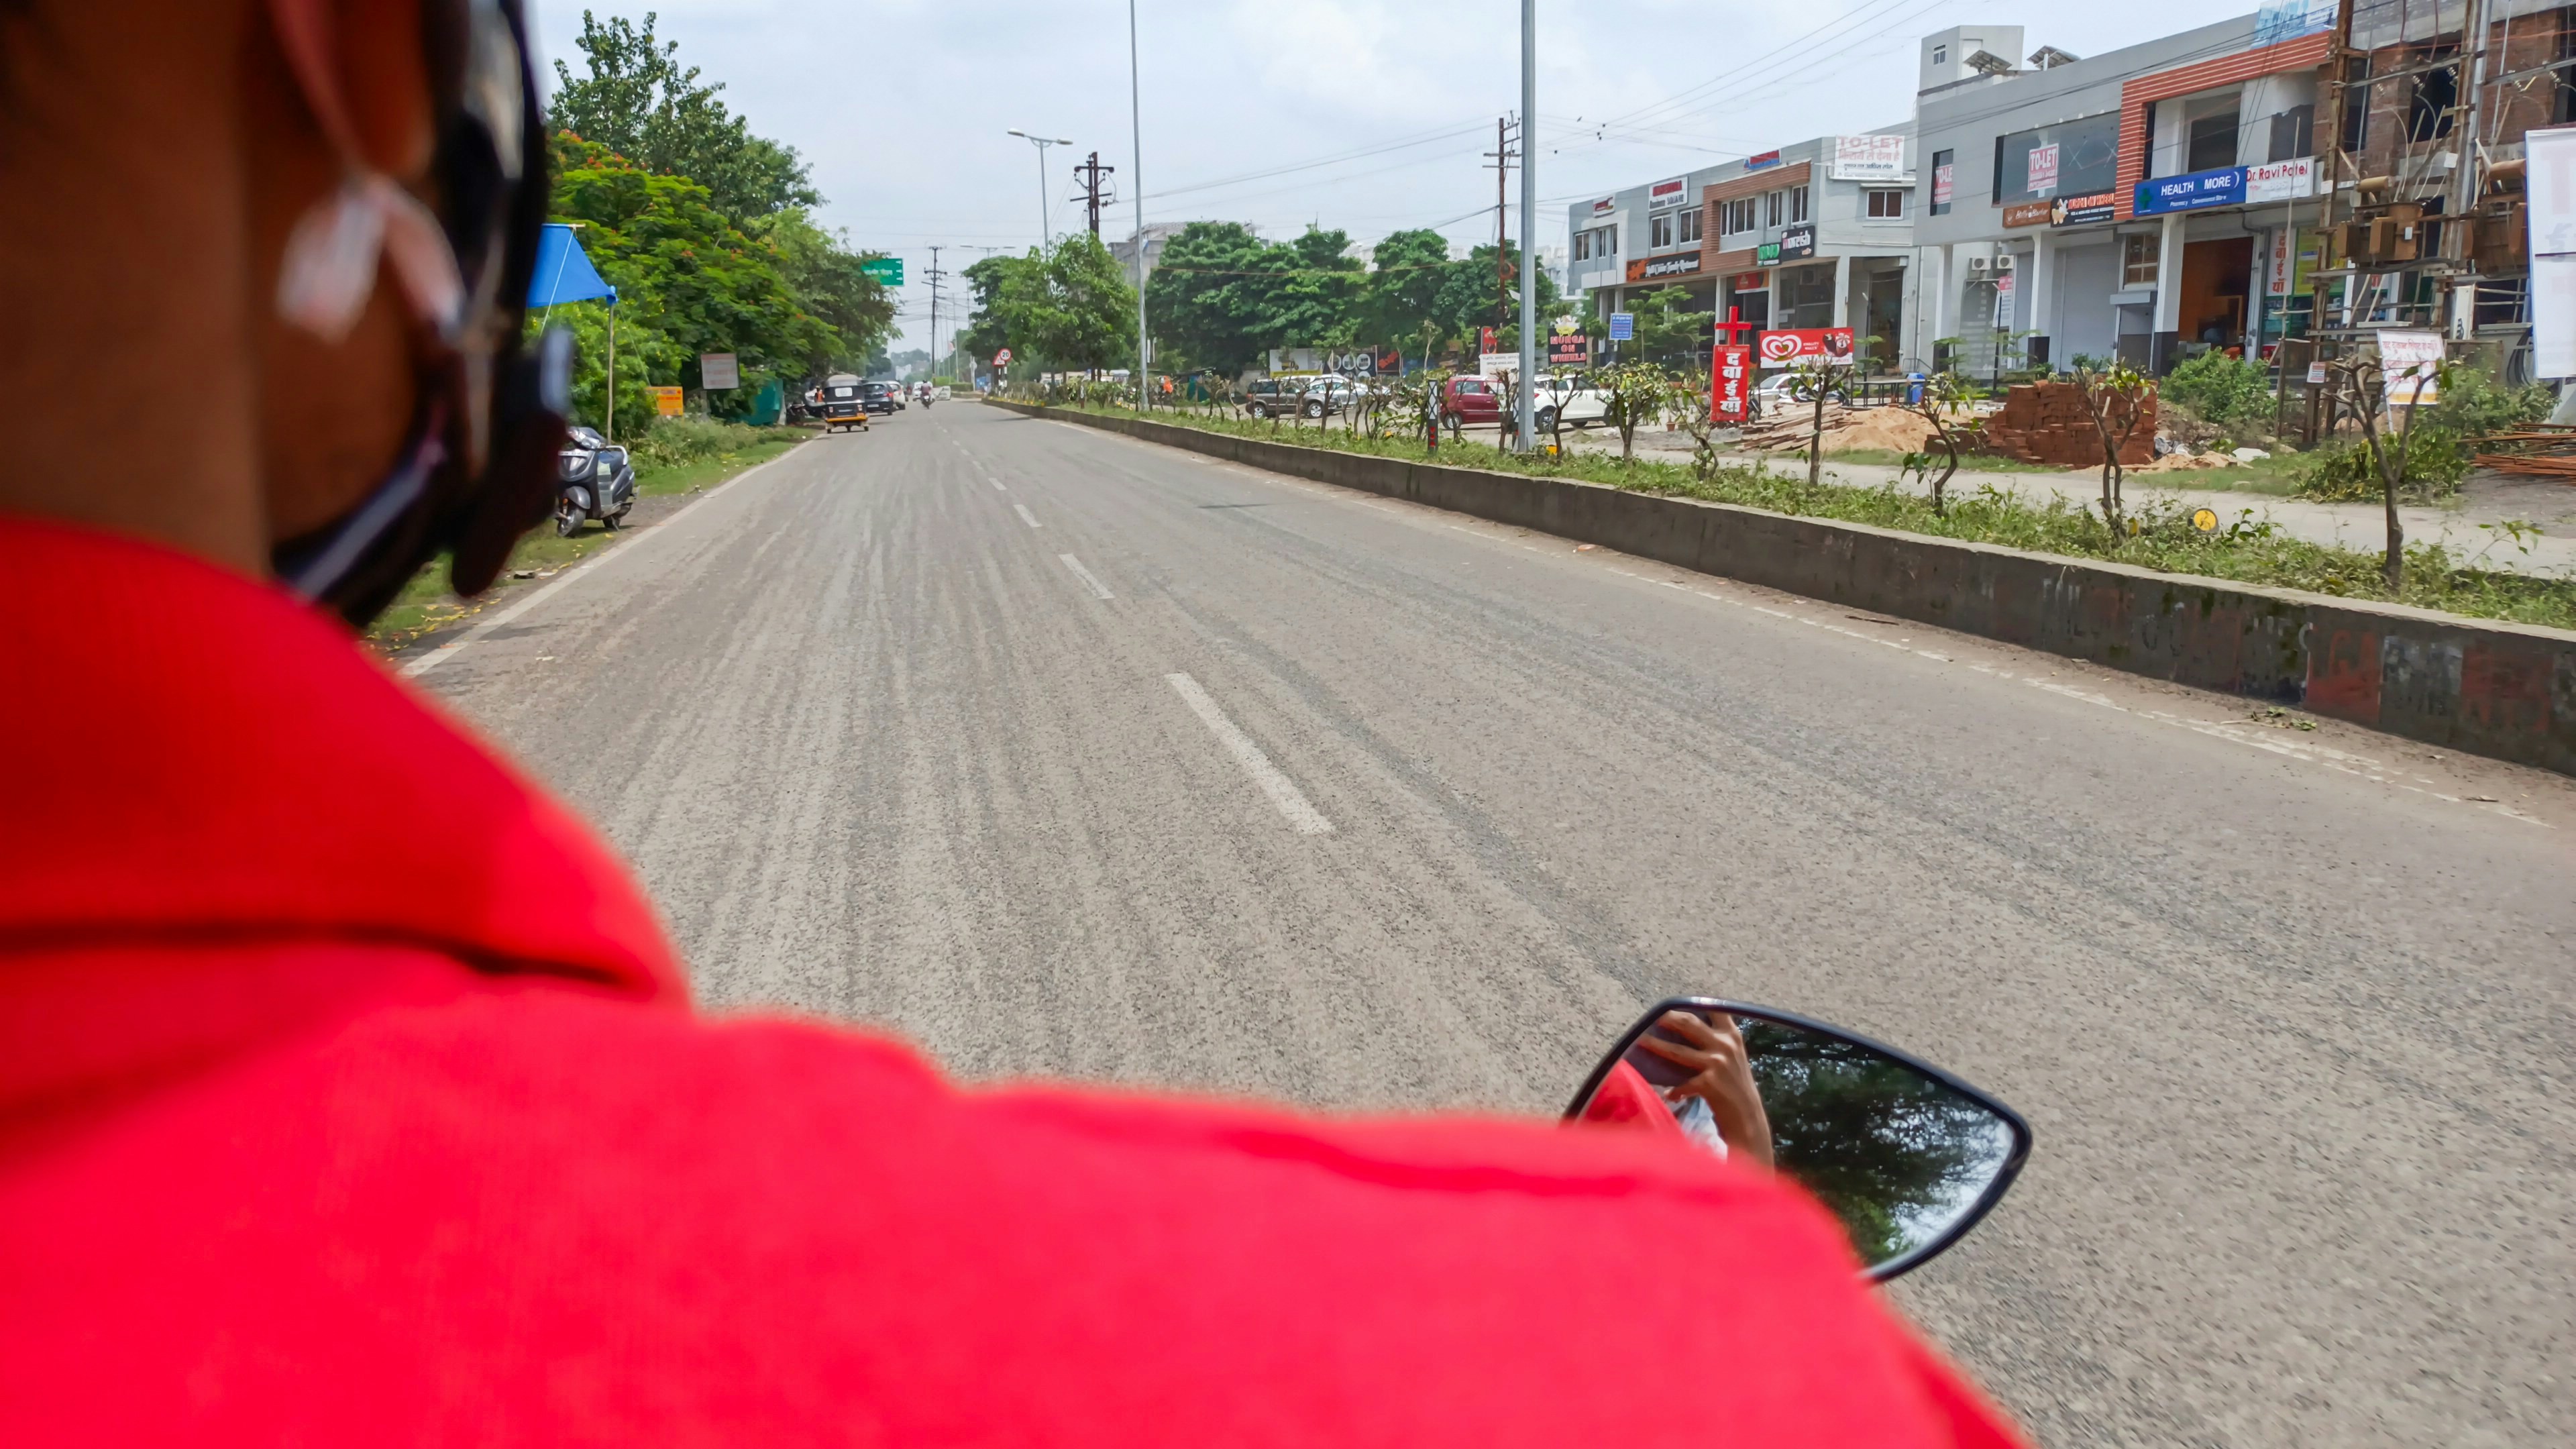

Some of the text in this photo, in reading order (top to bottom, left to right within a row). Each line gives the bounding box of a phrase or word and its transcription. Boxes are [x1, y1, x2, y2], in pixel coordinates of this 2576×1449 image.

[1837, 136, 1903, 149] TO-LET
[2031, 148, 2057, 171] TO-LET
[2246, 161, 2308, 182] Dr. Ravi Patel
[2161, 175, 2232, 196] HEALTH MORE
[2088, 195, 2096, 207] ON
[1550, 335, 1585, 344] MURGA
[1561, 344, 1575, 352] ON
[1550, 353, 1587, 362] WHEELS
